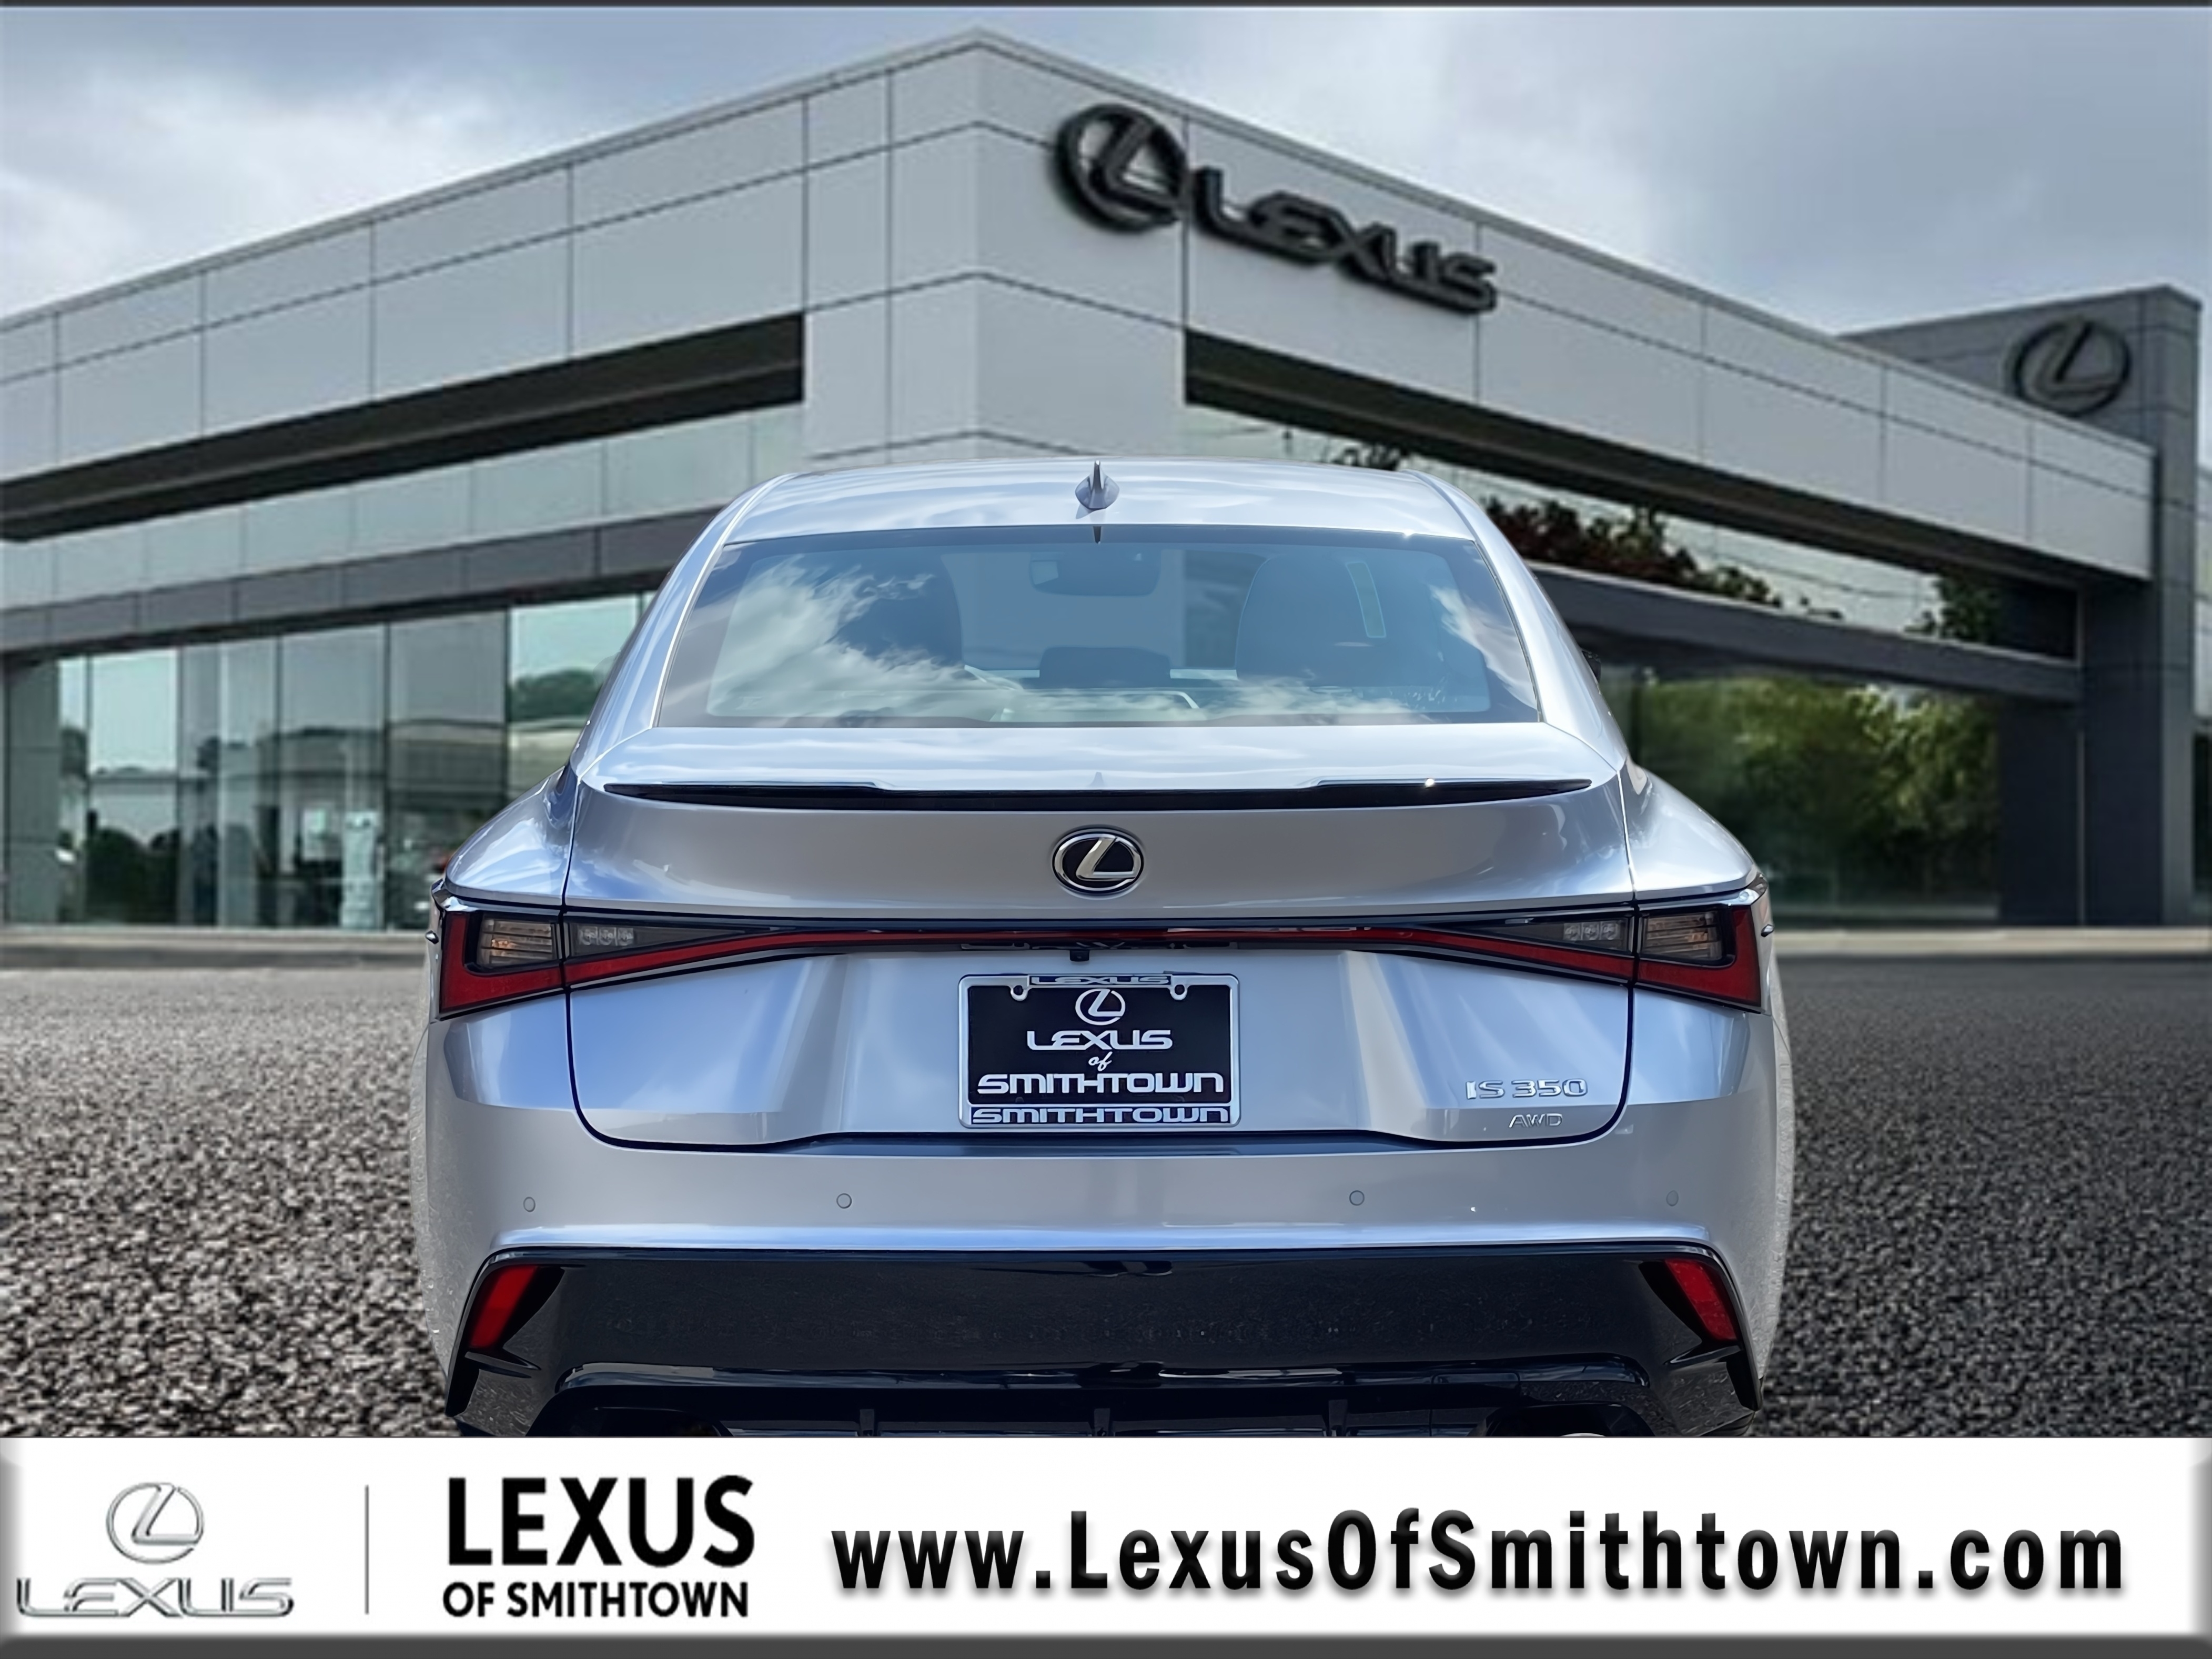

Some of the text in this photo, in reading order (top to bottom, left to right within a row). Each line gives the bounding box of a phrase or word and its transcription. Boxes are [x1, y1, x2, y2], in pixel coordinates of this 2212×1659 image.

[1192, 167, 1498, 315] LEXUS
[1031, 976, 1170, 985] LEXUS
[1026, 1030, 1173, 1050] LEXUS
[1088, 1051, 1113, 1071] of
[977, 1072, 1224, 1094] SMITHTOWN
[1465, 1079, 1588, 1099] IS 350
[972, 1107, 1228, 1123] SMITHTOWN
[1508, 1113, 1563, 1129] AWD
